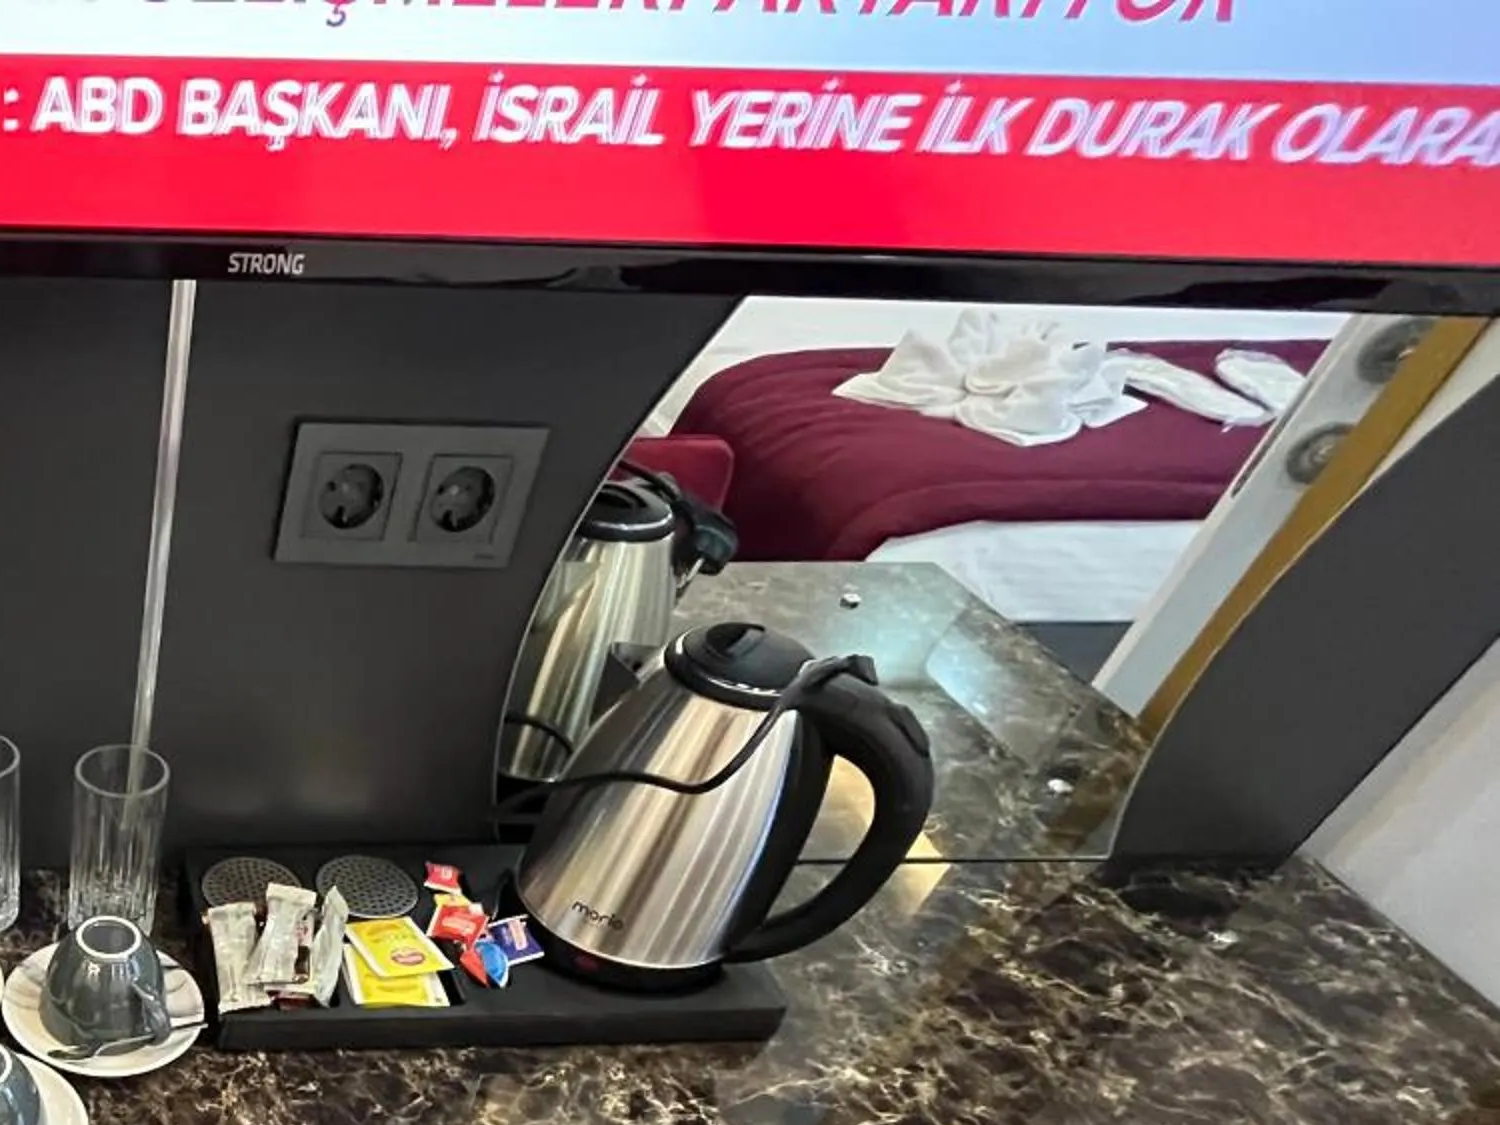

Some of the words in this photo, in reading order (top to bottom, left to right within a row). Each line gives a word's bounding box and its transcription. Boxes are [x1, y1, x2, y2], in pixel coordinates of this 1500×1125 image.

[30, 75, 164, 135] ABD
[176, 78, 457, 152] BAŞKANI,
[473, 71, 666, 146] İSRAİL
[690, 79, 922, 154] YERİNE
[917, 80, 1035, 156] İLK
[1025, 97, 1282, 162] DURAK
[227, 252, 306, 276] STRONG
